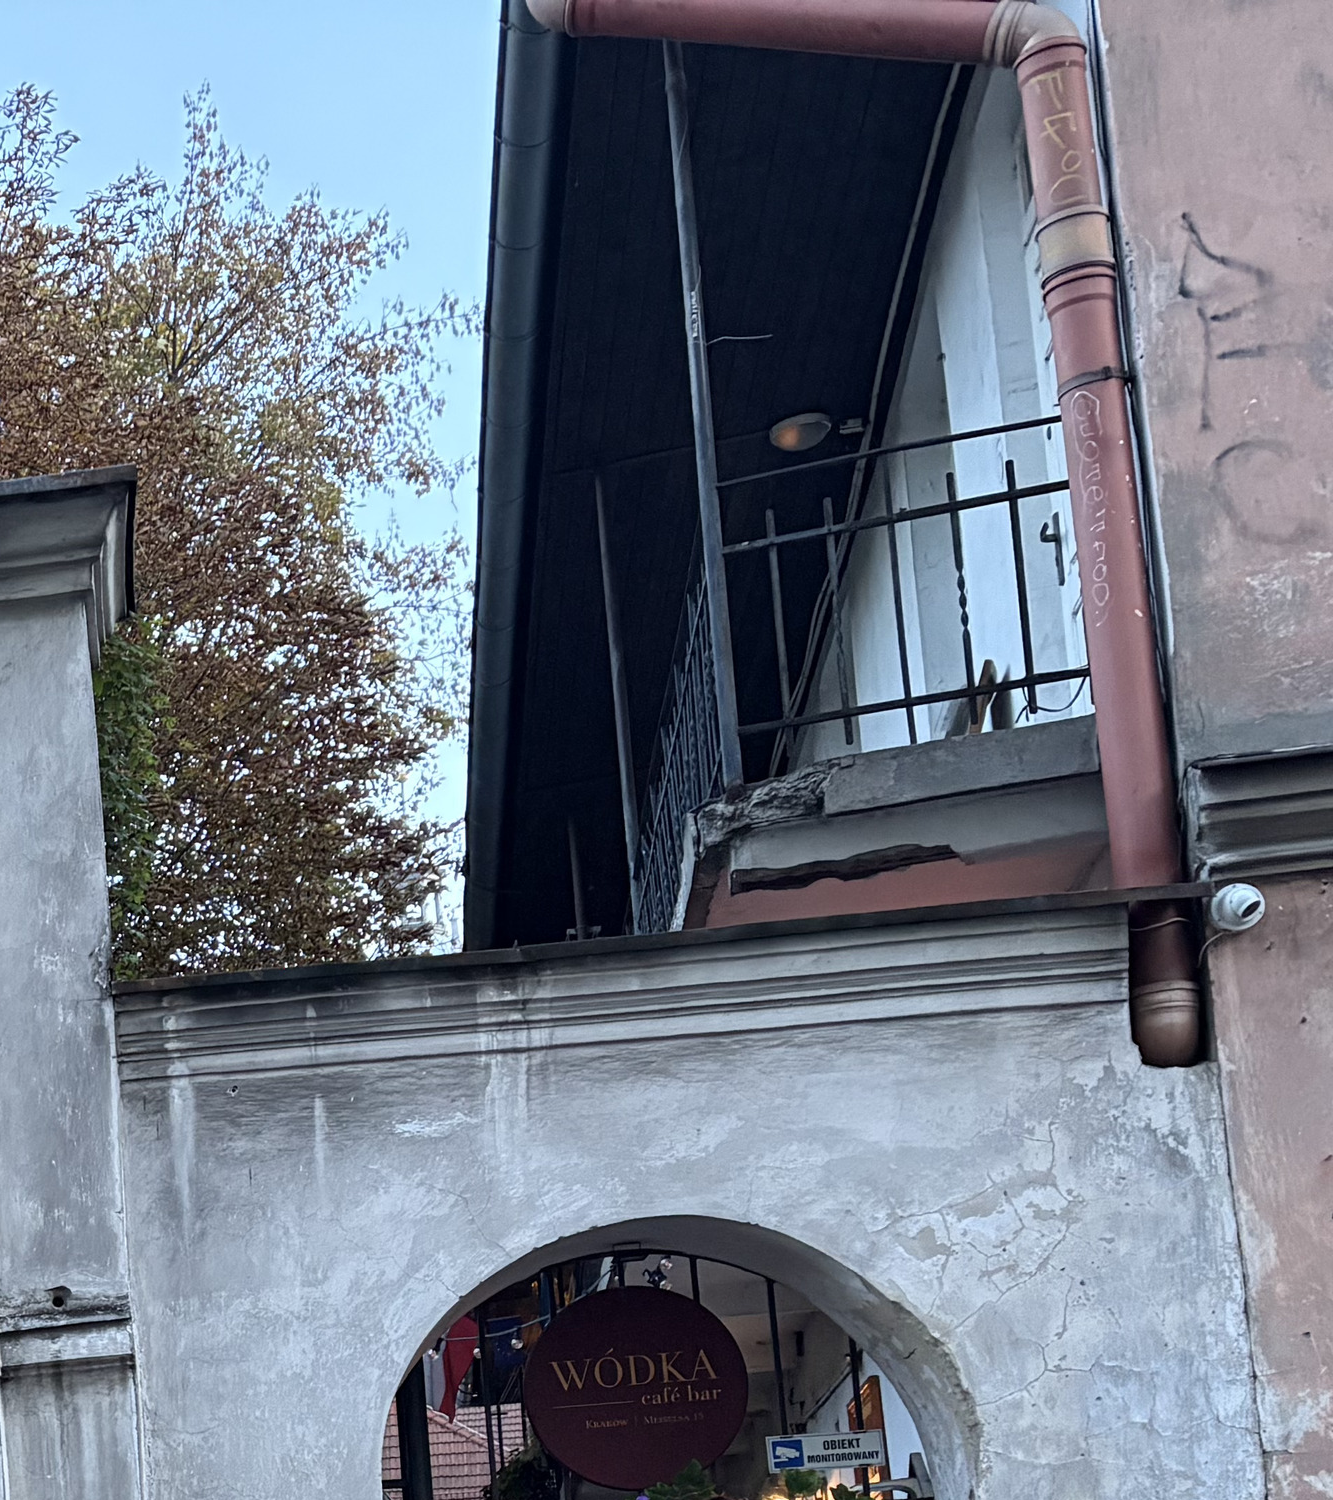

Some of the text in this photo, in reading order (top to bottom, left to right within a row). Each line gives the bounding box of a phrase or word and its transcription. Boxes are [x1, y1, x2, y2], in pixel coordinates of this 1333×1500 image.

[549, 1348, 720, 1391] WÓDKA
[641, 1385, 722, 1406] café bar
[822, 1438, 862, 1450] OBIEKT
[807, 1450, 880, 1463] MONITOROWANY
